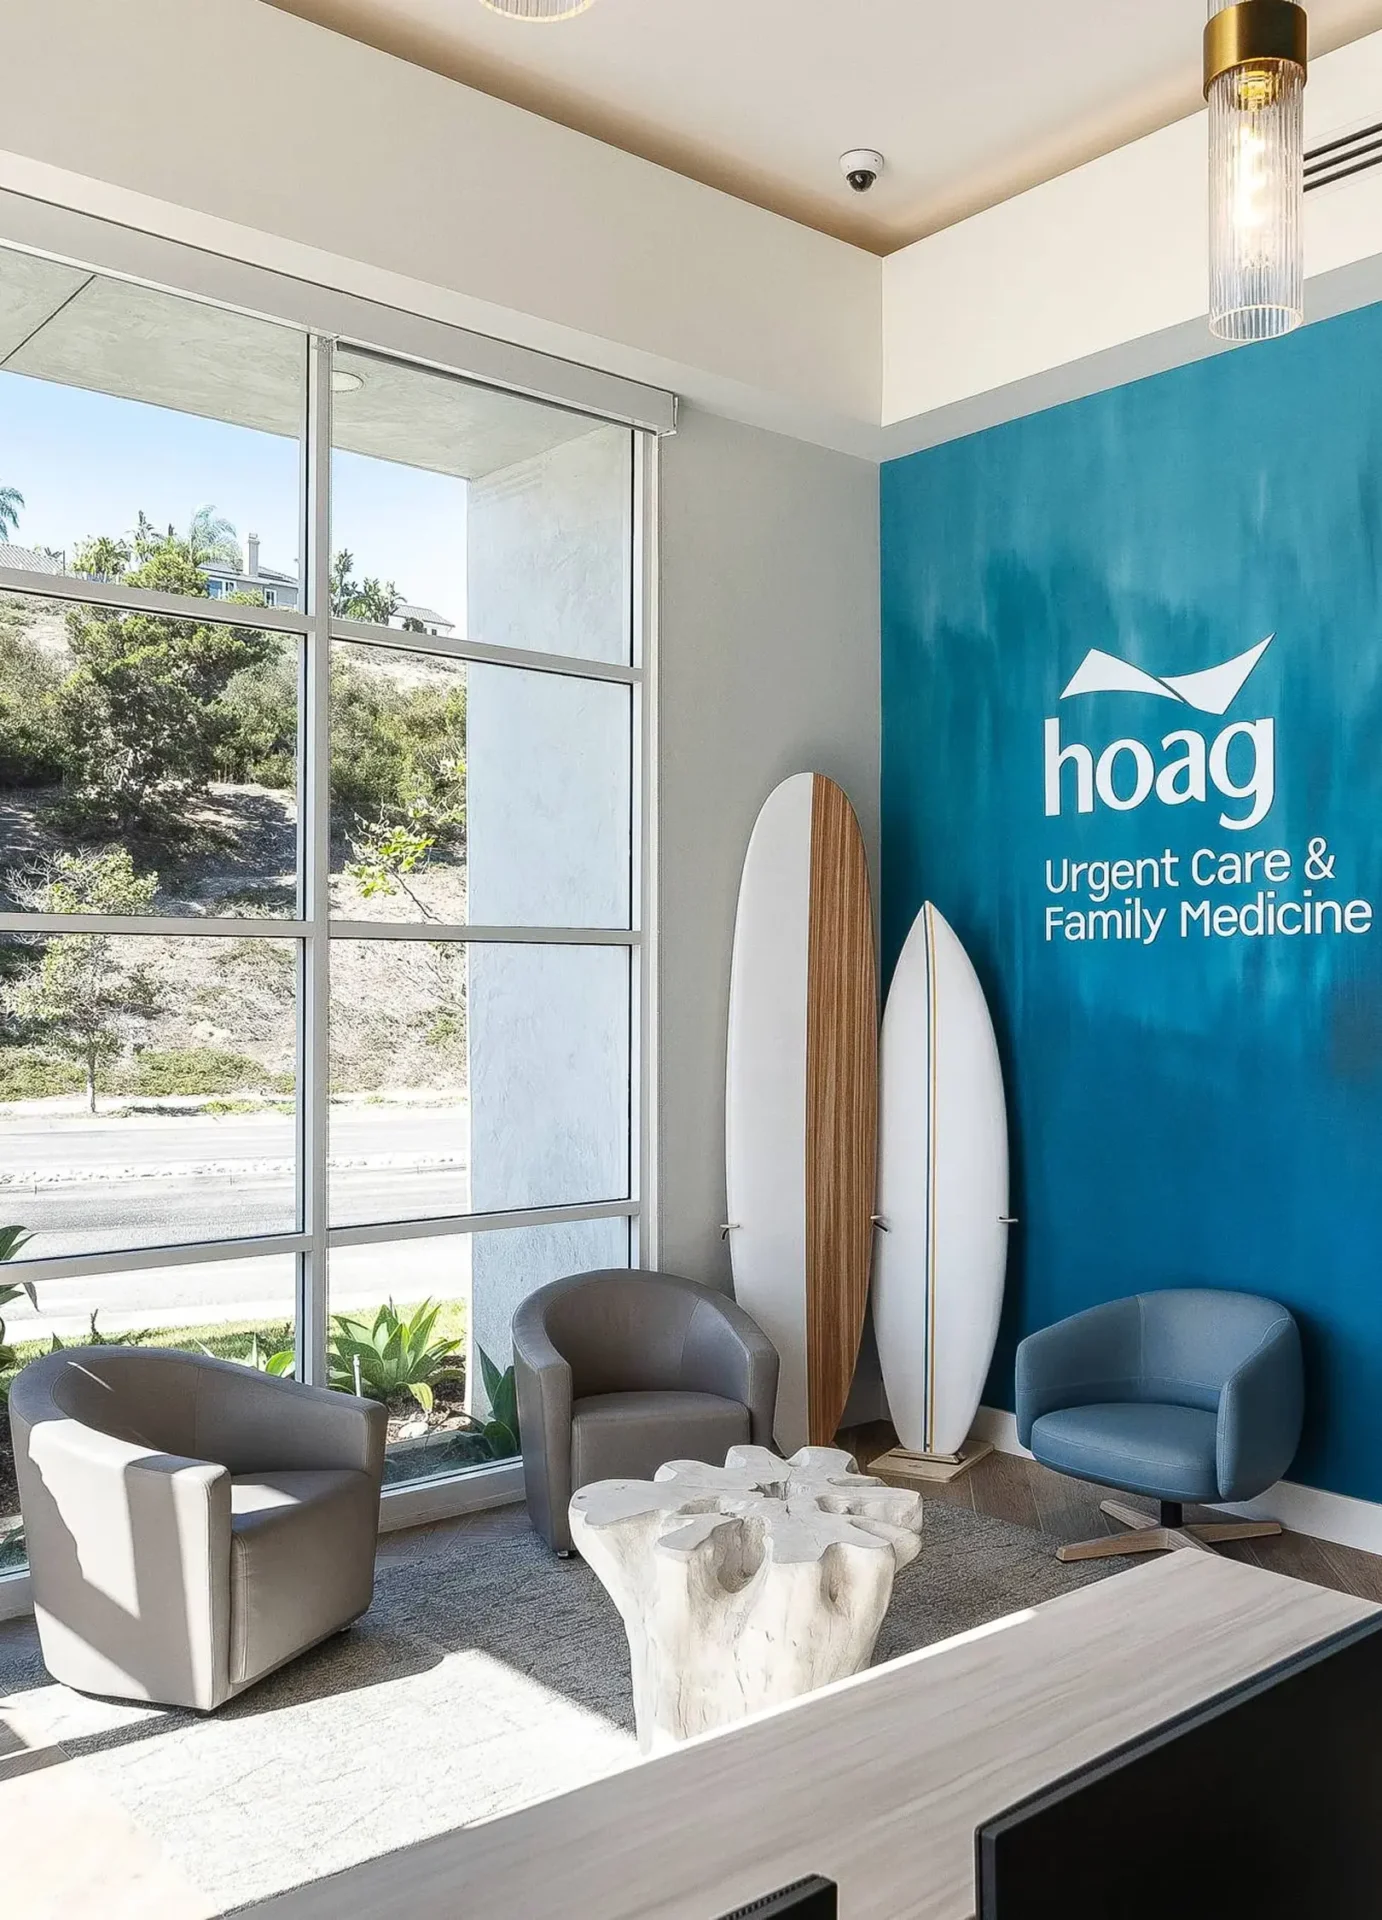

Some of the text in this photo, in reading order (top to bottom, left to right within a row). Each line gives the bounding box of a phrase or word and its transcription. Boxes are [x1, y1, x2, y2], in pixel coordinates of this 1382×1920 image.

[1045, 717, 1275, 830] hoag
[1046, 837, 1336, 902] Urgent Care &
[1045, 889, 1373, 944] Family Medicine
